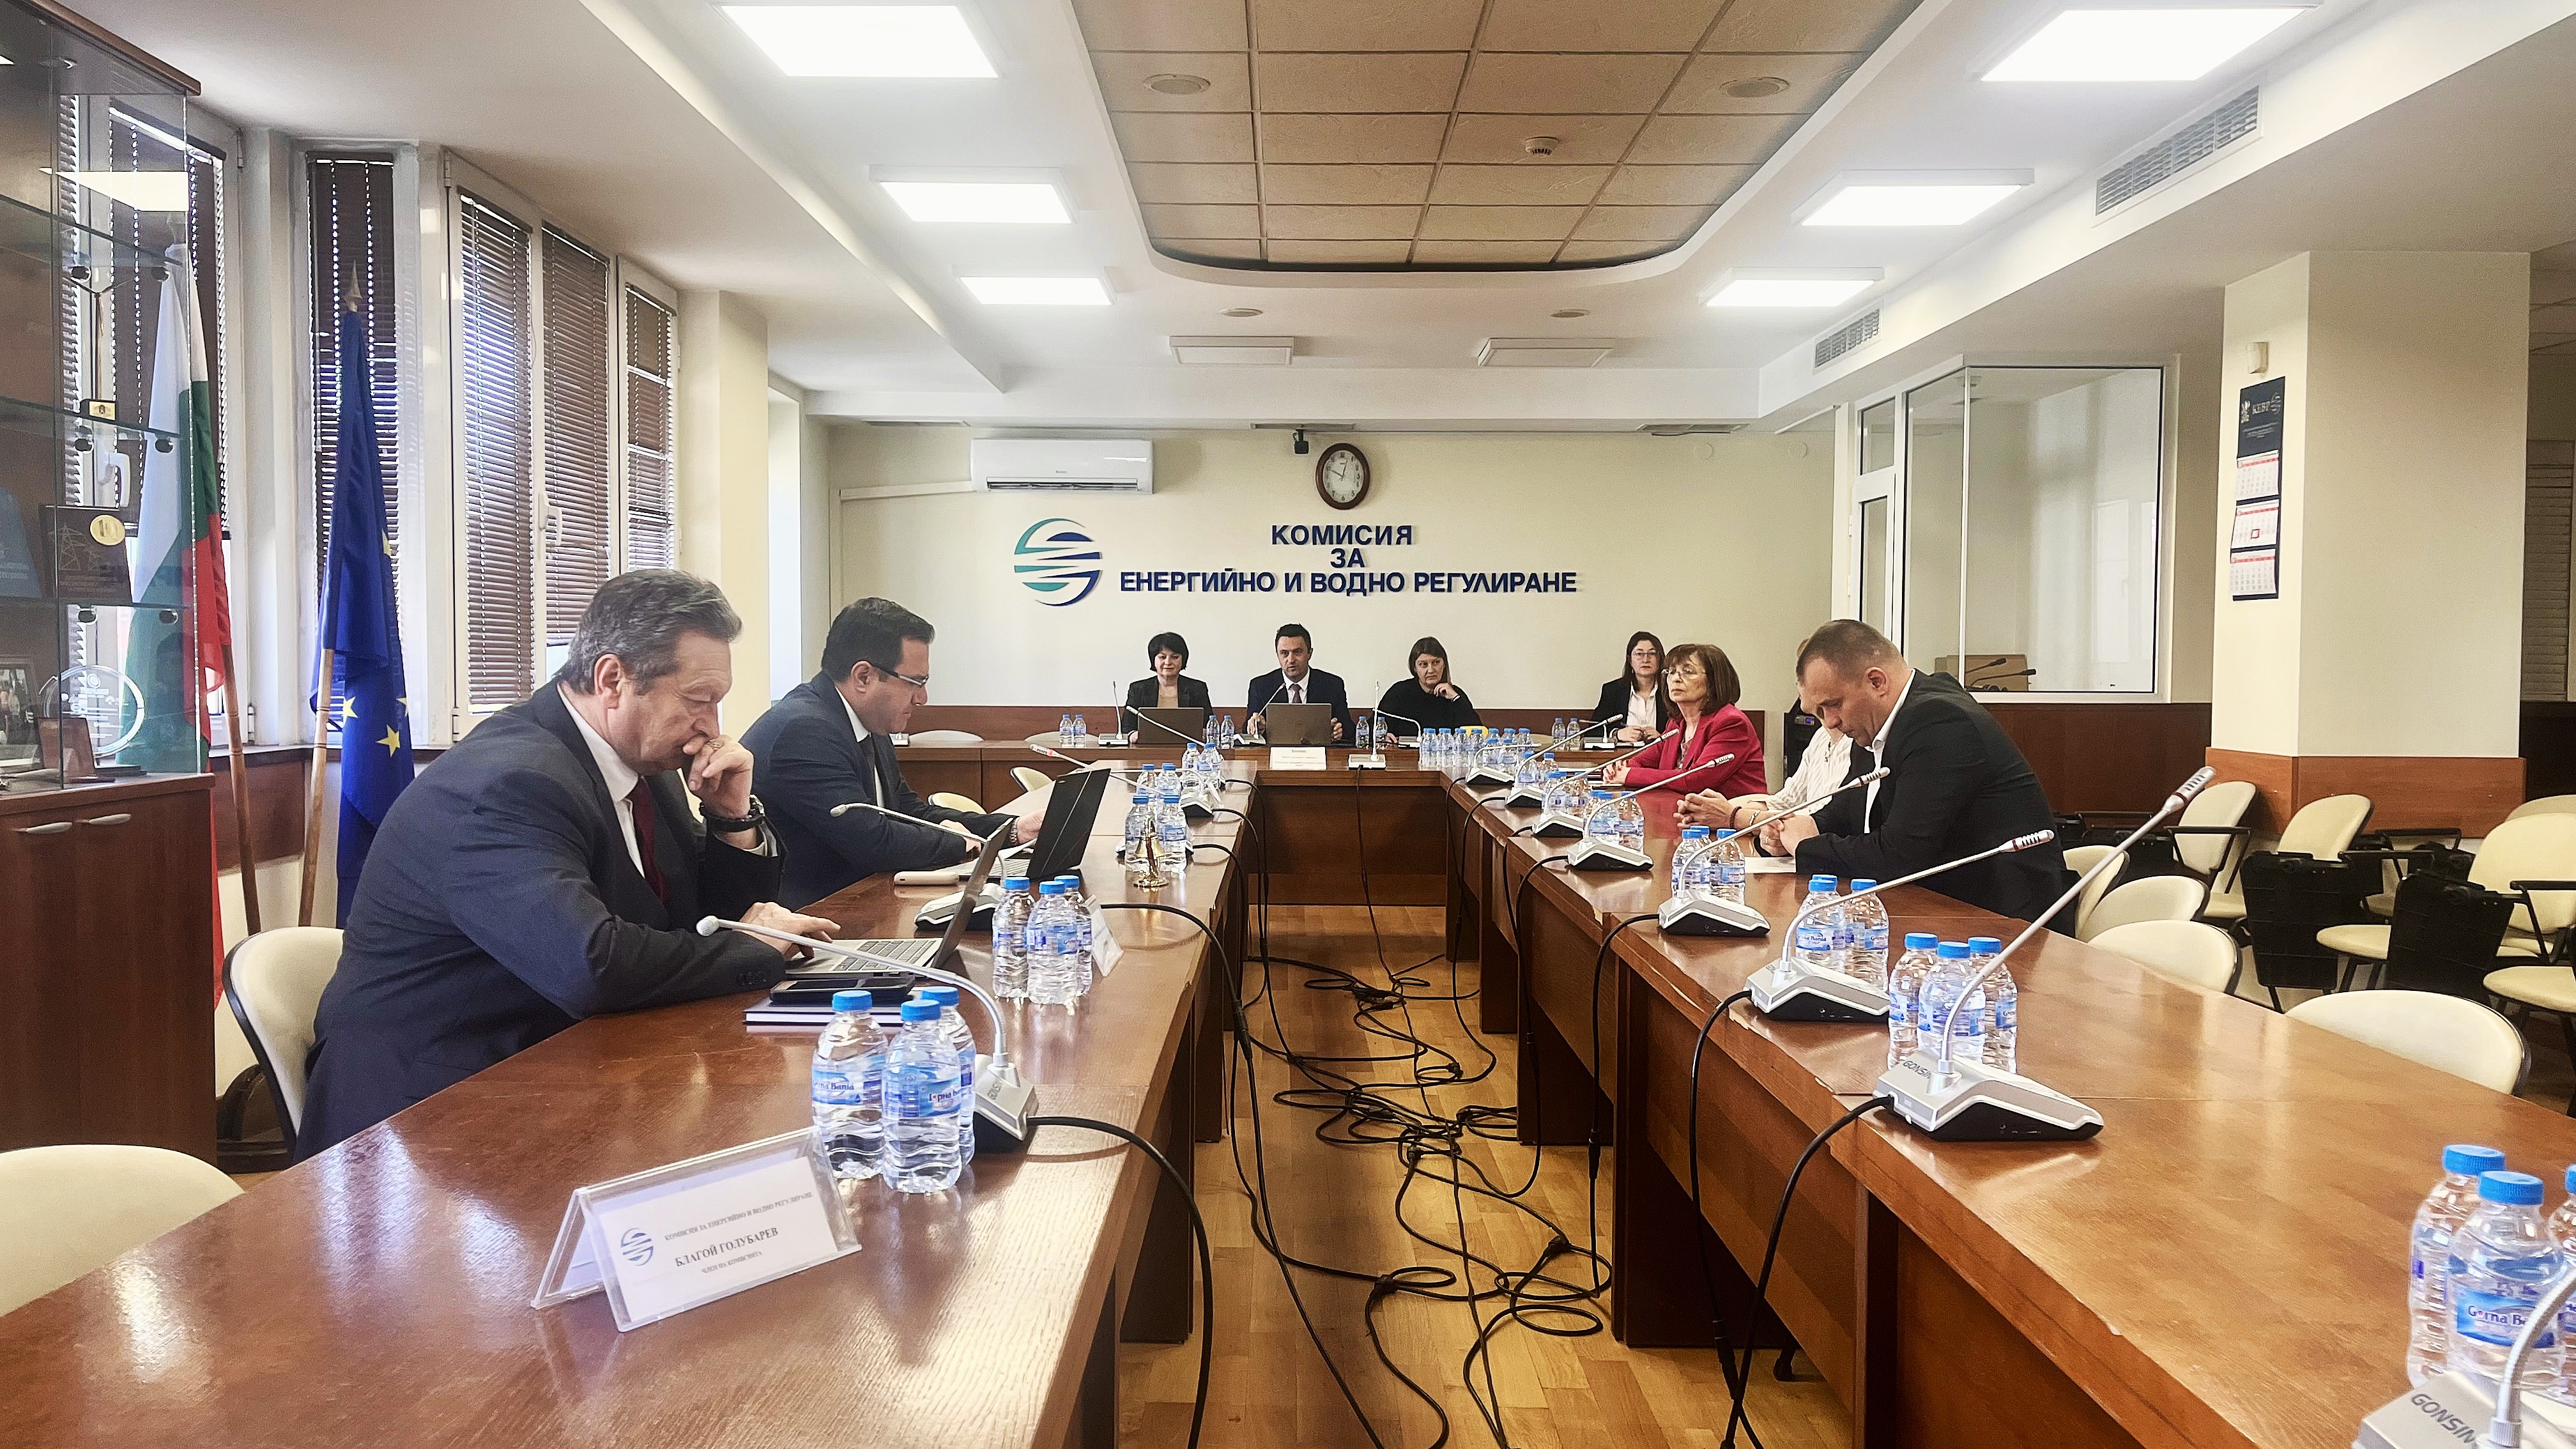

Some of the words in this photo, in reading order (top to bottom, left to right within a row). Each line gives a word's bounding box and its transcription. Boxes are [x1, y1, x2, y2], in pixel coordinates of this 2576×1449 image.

[1271, 525, 1413, 546] КОМИСИЯ
[1330, 548, 1366, 568] ЗА
[1120, 568, 1276, 592] ЕНЕРГИЙНО
[1285, 572, 1301, 592] И
[1311, 572, 1405, 596] ВОДНО
[1414, 572, 1577, 592] РЕГУЛИРАНЕ
[664, 1226, 698, 1241] КОМИСИЯ
[707, 1211, 747, 1228] ЕНЕРГИЙНО
[752, 1204, 774, 1215] ВОДНО
[774, 1192, 813, 1208] РЕГУЛИРАНЕ
[675, 1245, 718, 1267] БЛАГОЙ
[719, 1227, 779, 1253] ГОЛУБАРЕВ
[2468, 1305, 2508, 1324] Gorna
[2411, 1393, 2476, 1443] GONSIN
